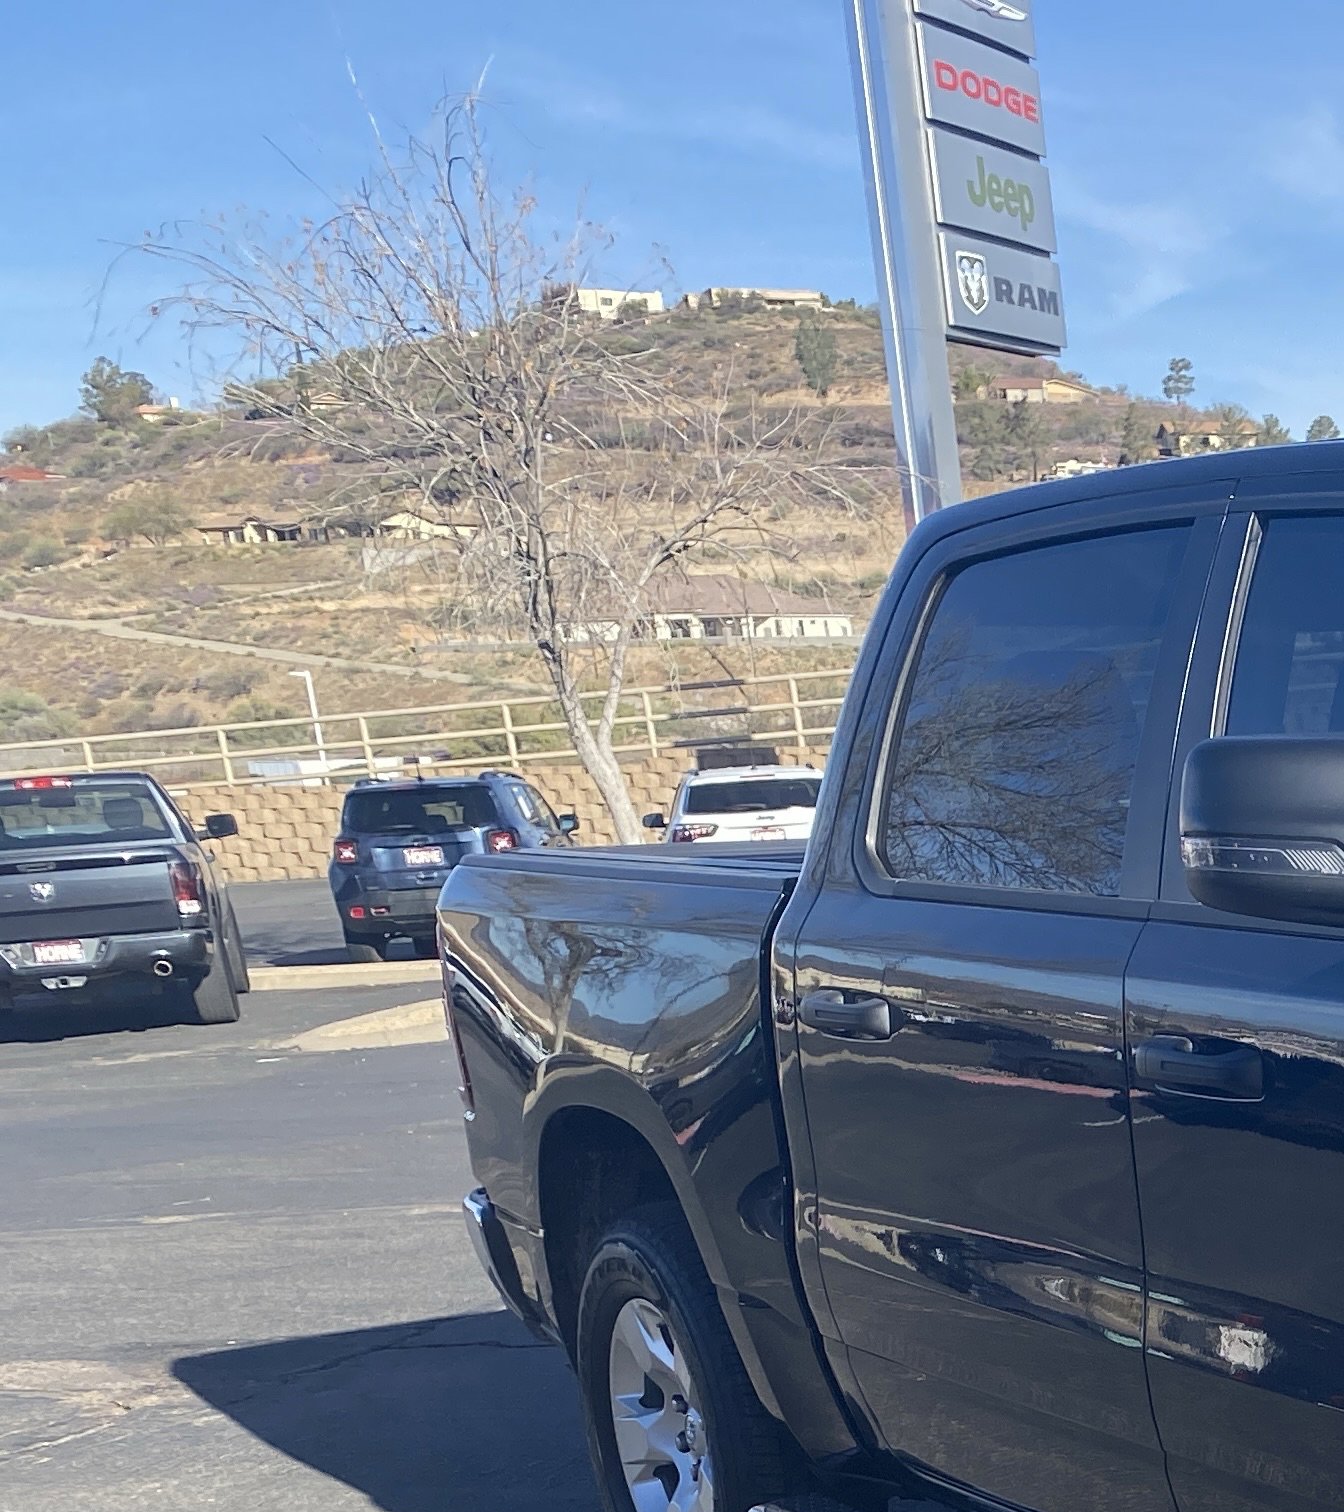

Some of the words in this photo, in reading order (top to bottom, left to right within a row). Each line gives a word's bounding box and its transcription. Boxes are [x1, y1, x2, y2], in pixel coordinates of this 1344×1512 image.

[933, 59, 1039, 123] DODGE
[966, 155, 1035, 231] Jeep
[992, 275, 1060, 317] RAM
